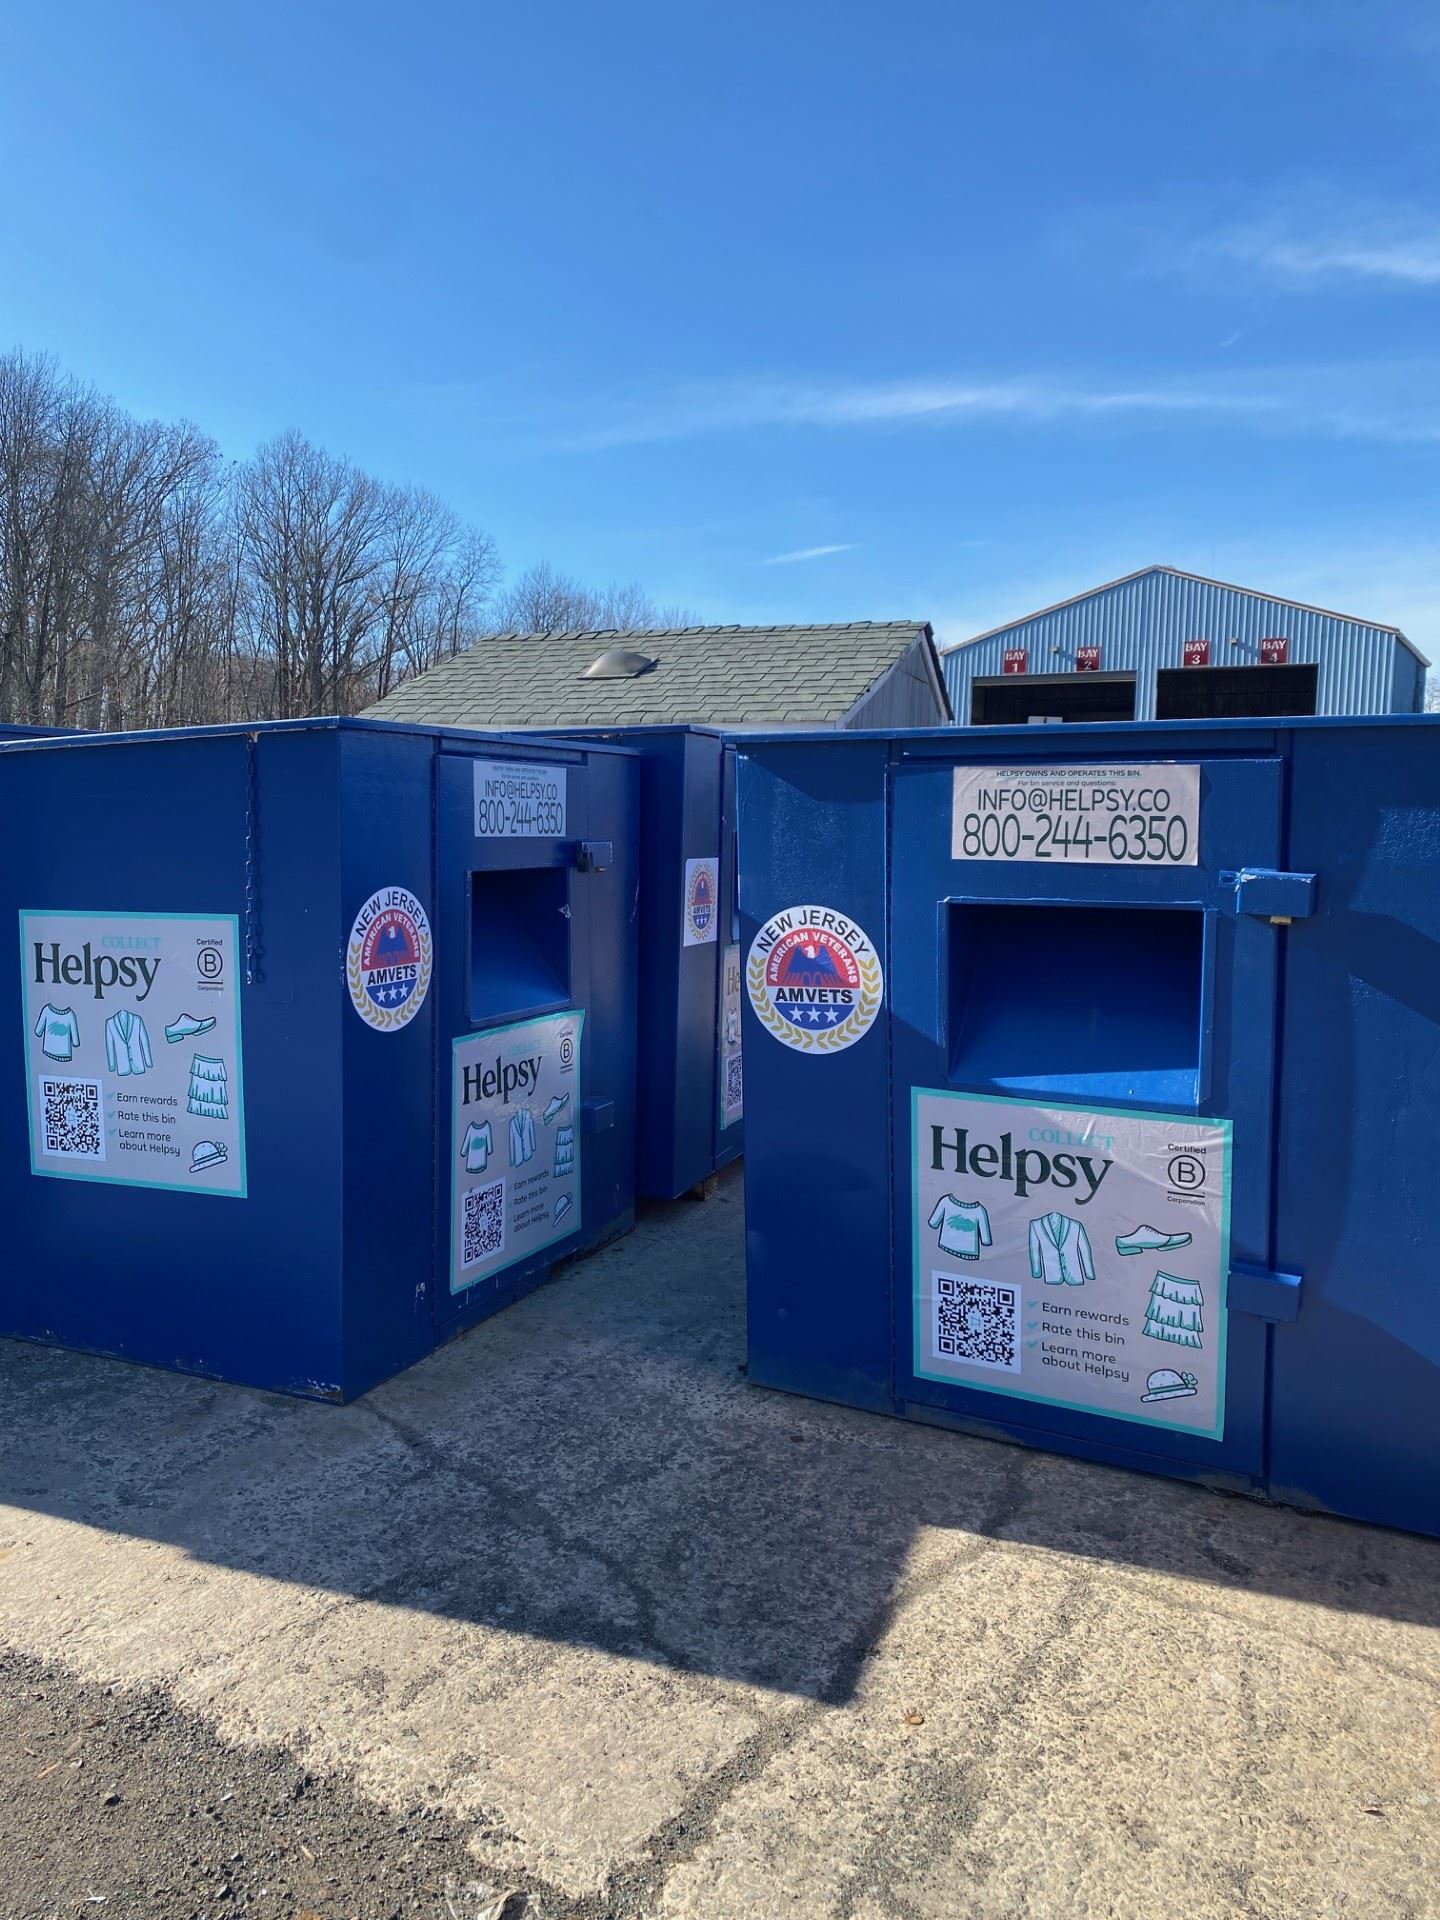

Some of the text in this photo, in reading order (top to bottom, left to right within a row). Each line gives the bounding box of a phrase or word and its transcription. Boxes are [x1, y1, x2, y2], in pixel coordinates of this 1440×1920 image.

[1078, 648, 1099, 659] BAY
[1185, 642, 1207, 653] BAY
[1263, 639, 1286, 650] BAY
[1005, 651, 1025, 661] BAY
[1084, 660, 1092, 671] 2
[1191, 654, 1201, 665] 3
[1269, 652, 1279, 663] 4
[1012, 663, 1019, 673] 1
[485, 780, 557, 800] INFO@HELPSY.CO
[978, 788, 1171, 812] INFO@HELPSY.CO
[479, 799, 563, 834] 800-244-6350
[963, 813, 1187, 861] 800-244-6350
[354, 891, 427, 938] NEW JERSEY
[102, 936, 161, 949] COLLECT
[196, 938, 223, 946] Certified
[364, 913, 420, 966] AMERICAN VETERANS
[757, 910, 870, 955] NEW JERSEY
[770, 932, 809, 982] AMERICAN
[812, 932, 858, 984] VETERANS
[33, 942, 161, 1001] Helpsy
[367, 964, 417, 986] AMVETS
[775, 987, 853, 1003] AMVETS
[462, 1055, 542, 1105] Helpsy
[117, 1092, 178, 1106] Earn rewards
[118, 1111, 176, 1124] Rate this bin
[118, 1128, 171, 1142] Learn more
[119, 1141, 180, 1157] about Helpsy
[1167, 1143, 1206, 1154] Certified
[930, 1125, 1114, 1205] Helpsy
[1178, 1161, 1196, 1183] B
[1042, 1302, 1130, 1326] Earn rewards
[1042, 1322, 1125, 1345] Rate this bin
[1041, 1342, 1116, 1364] Learn more
[1042, 1356, 1130, 1382] about Helpsy
